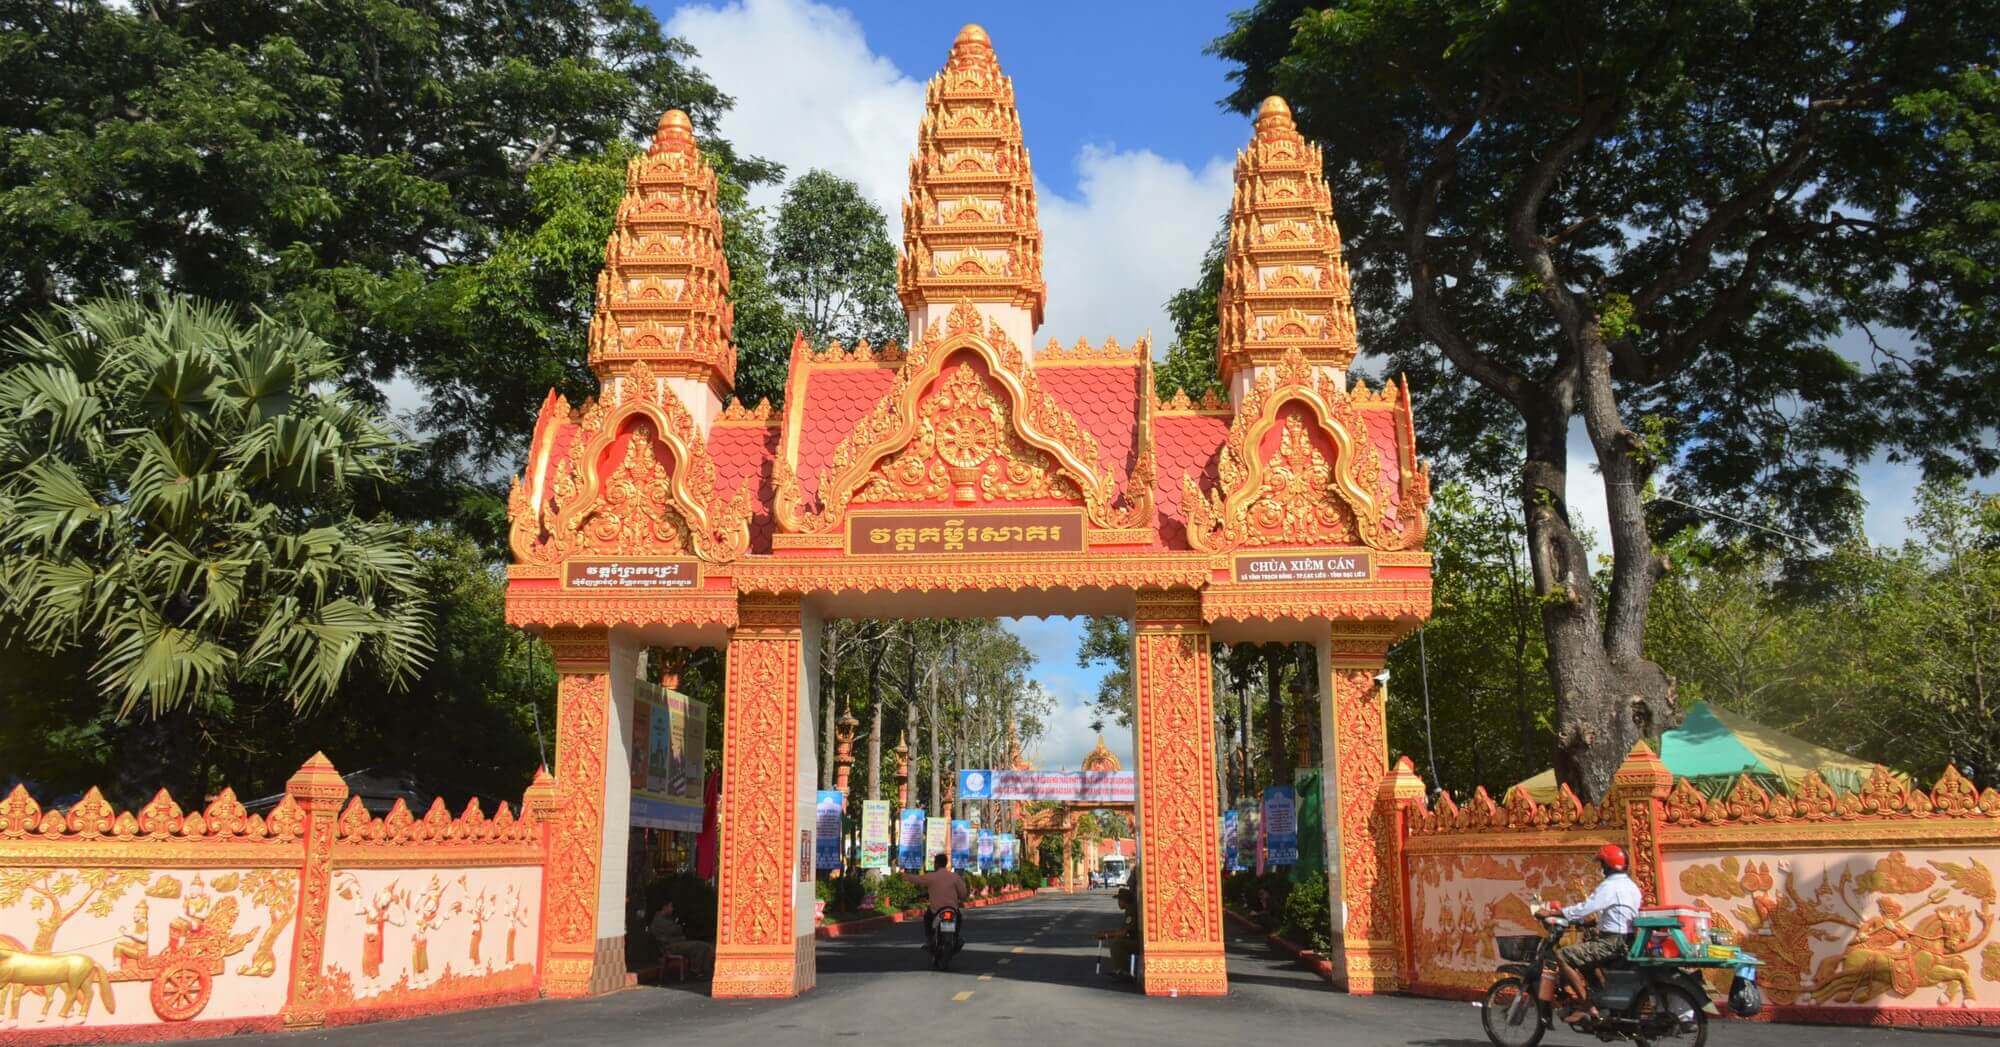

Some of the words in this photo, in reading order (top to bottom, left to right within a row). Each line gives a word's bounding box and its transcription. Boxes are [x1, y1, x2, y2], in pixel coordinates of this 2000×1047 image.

[1250, 558, 1288, 572] CHÙA
[1290, 558, 1324, 571] XIÊM
[1327, 557, 1355, 570] CÁN
